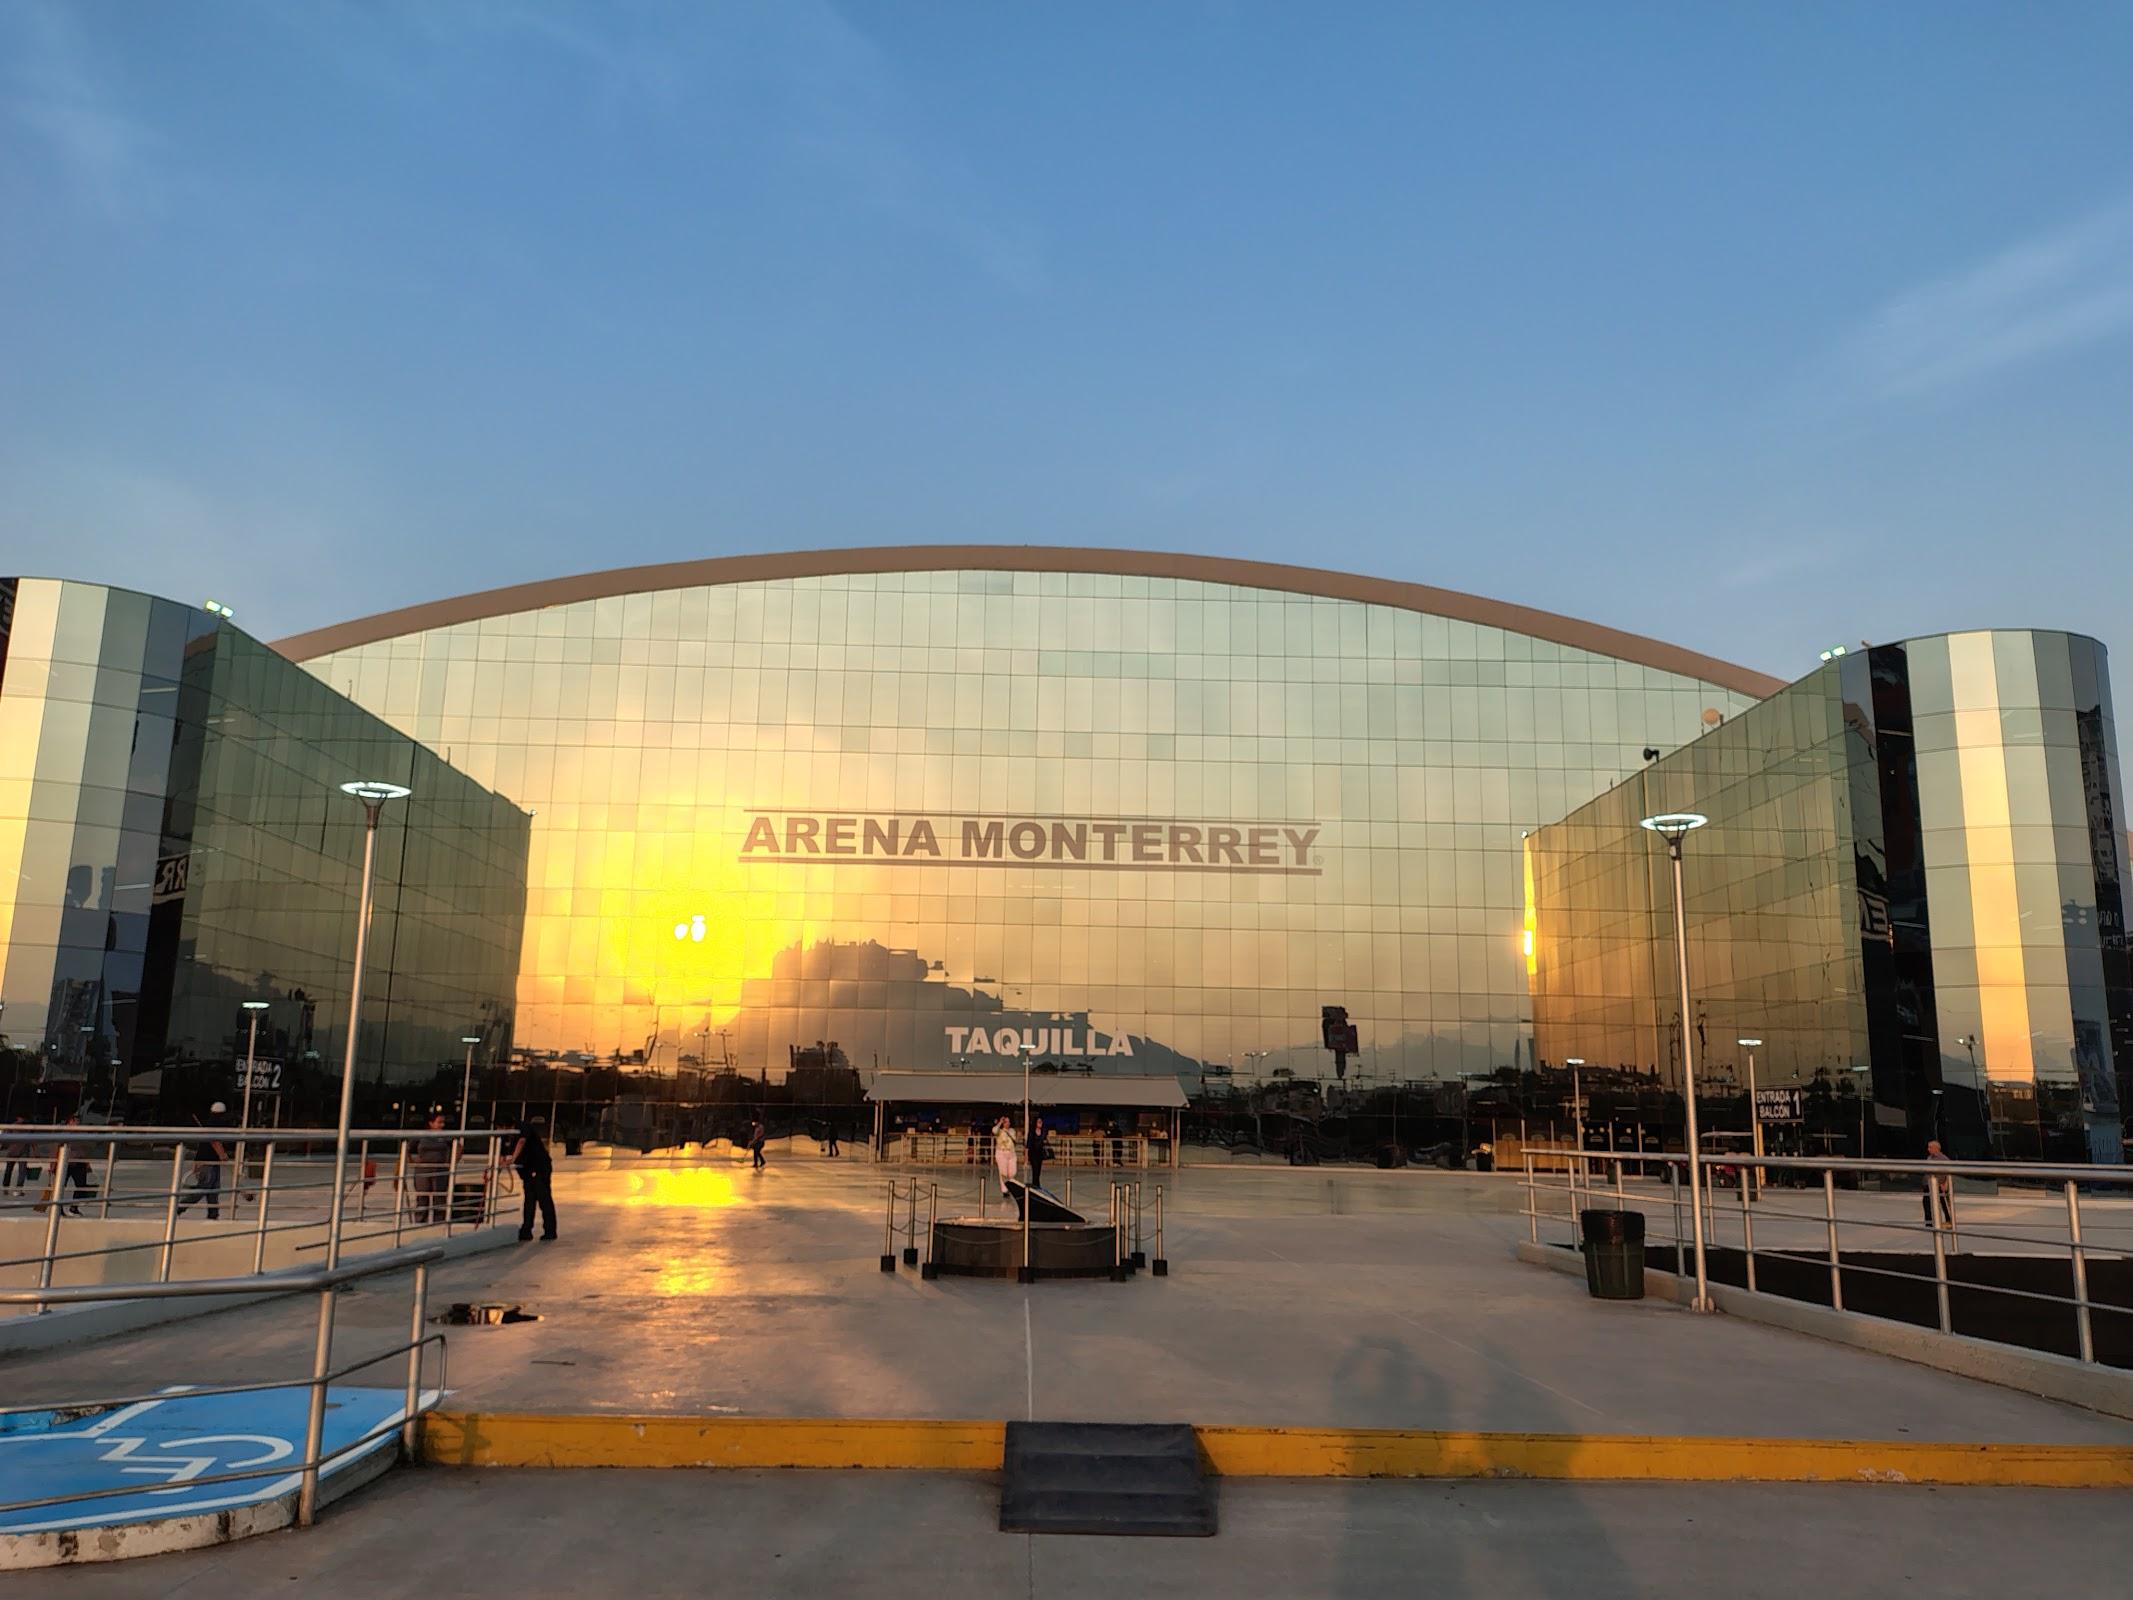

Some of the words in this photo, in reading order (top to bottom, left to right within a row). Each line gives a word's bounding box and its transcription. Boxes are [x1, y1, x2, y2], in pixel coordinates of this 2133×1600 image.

[742, 816, 941, 857] ARENA
[961, 820, 1321, 866] MONTERREY
[945, 1026, 1134, 1057] TAQUILLA
[235, 1059, 272, 1073] ENADA
[272, 1064, 281, 1088] 2
[1756, 1090, 1790, 1103] ENTRADA
[1793, 1090, 1800, 1116] 1
